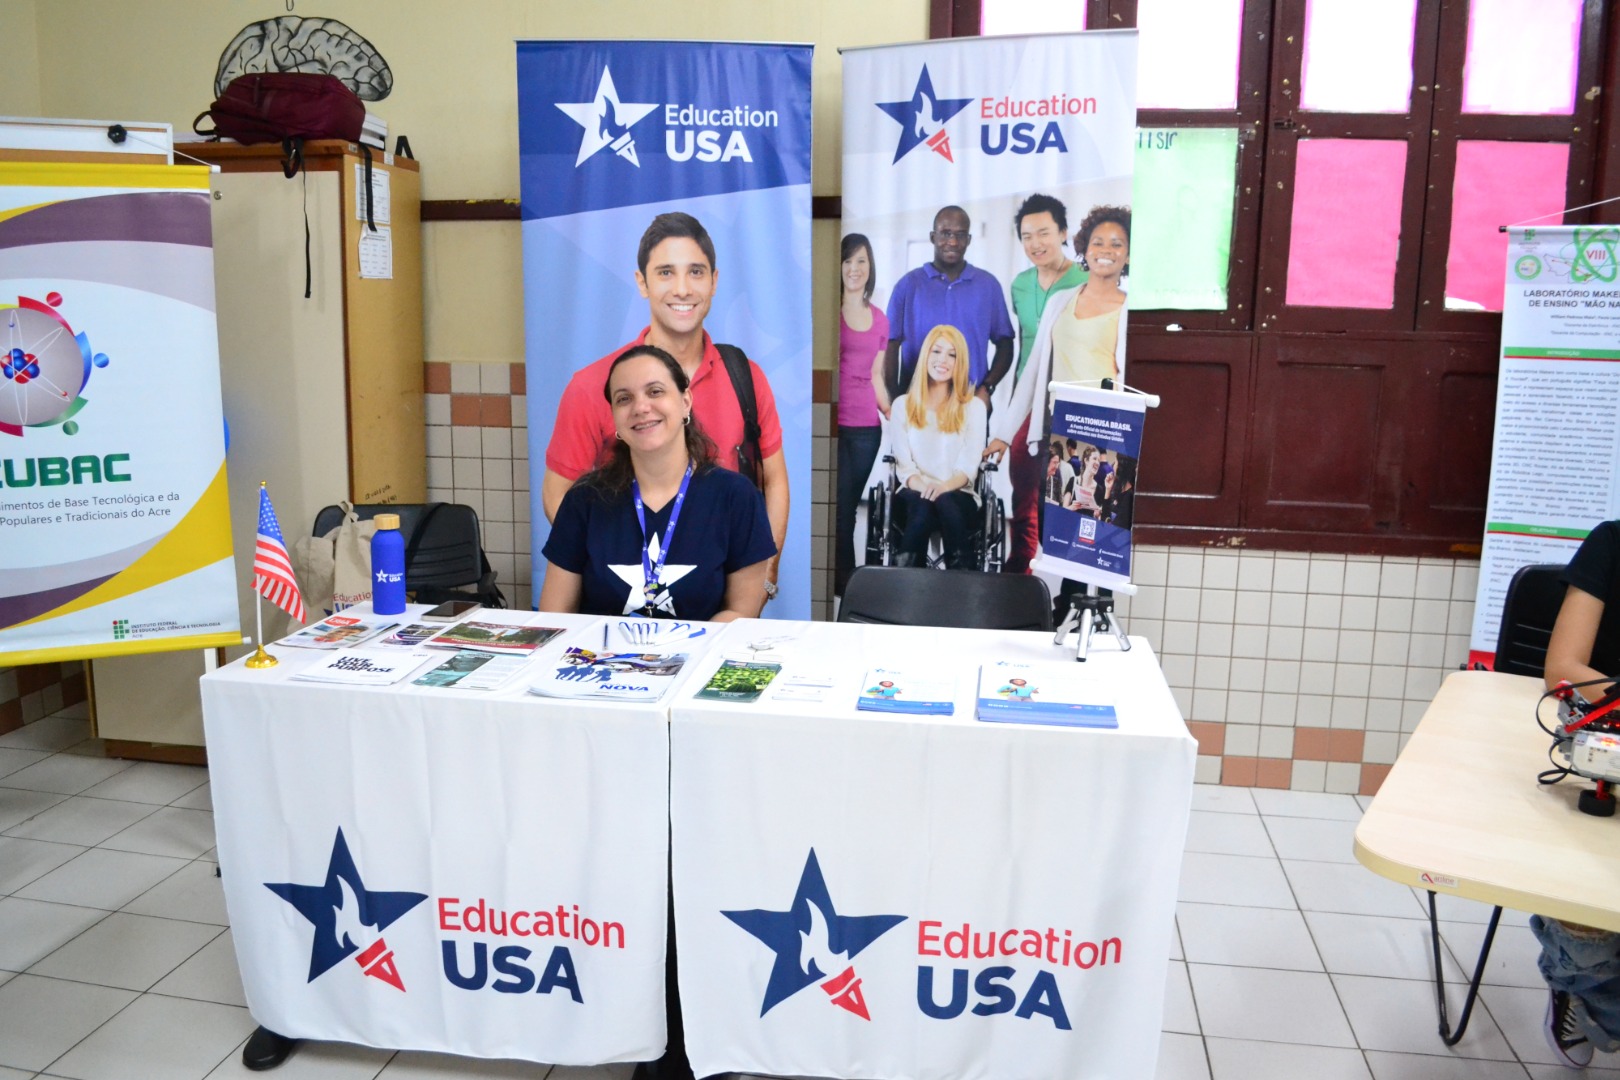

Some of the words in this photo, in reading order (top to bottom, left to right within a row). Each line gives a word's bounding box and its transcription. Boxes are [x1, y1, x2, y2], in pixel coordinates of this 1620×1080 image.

[980, 93, 1097, 119] Education
[665, 103, 778, 129] Education
[665, 130, 754, 163] USA
[980, 121, 1069, 156] USA
[1586, 250, 1606, 261] VIII
[1523, 289, 1590, 298] LABORATÓRIO
[1581, 300, 1606, 308] "MÃO
[1065, 414, 1110, 428] EDUCATIONUSA
[1110, 421, 1132, 432] BRASIL
[0, 501, 44, 511] imentos
[48, 499, 61, 508] de
[65, 498, 89, 508] Base
[92, 494, 155, 506] Tecnológica
[167, 492, 180, 501] da
[55, 515, 62, 523] e
[65, 510, 128, 522] Tradicionais
[131, 509, 145, 518] do
[148, 508, 171, 517] Acre
[332, 592, 372, 602] Educatio
[327, 664, 395, 673] PURPOSE
[336, 660, 374, 668] YOUR
[599, 683, 649, 691] NOVA
[438, 897, 626, 949] Education
[917, 920, 1123, 970] Education
[441, 940, 585, 1005] USA
[916, 965, 1073, 1031] USA
